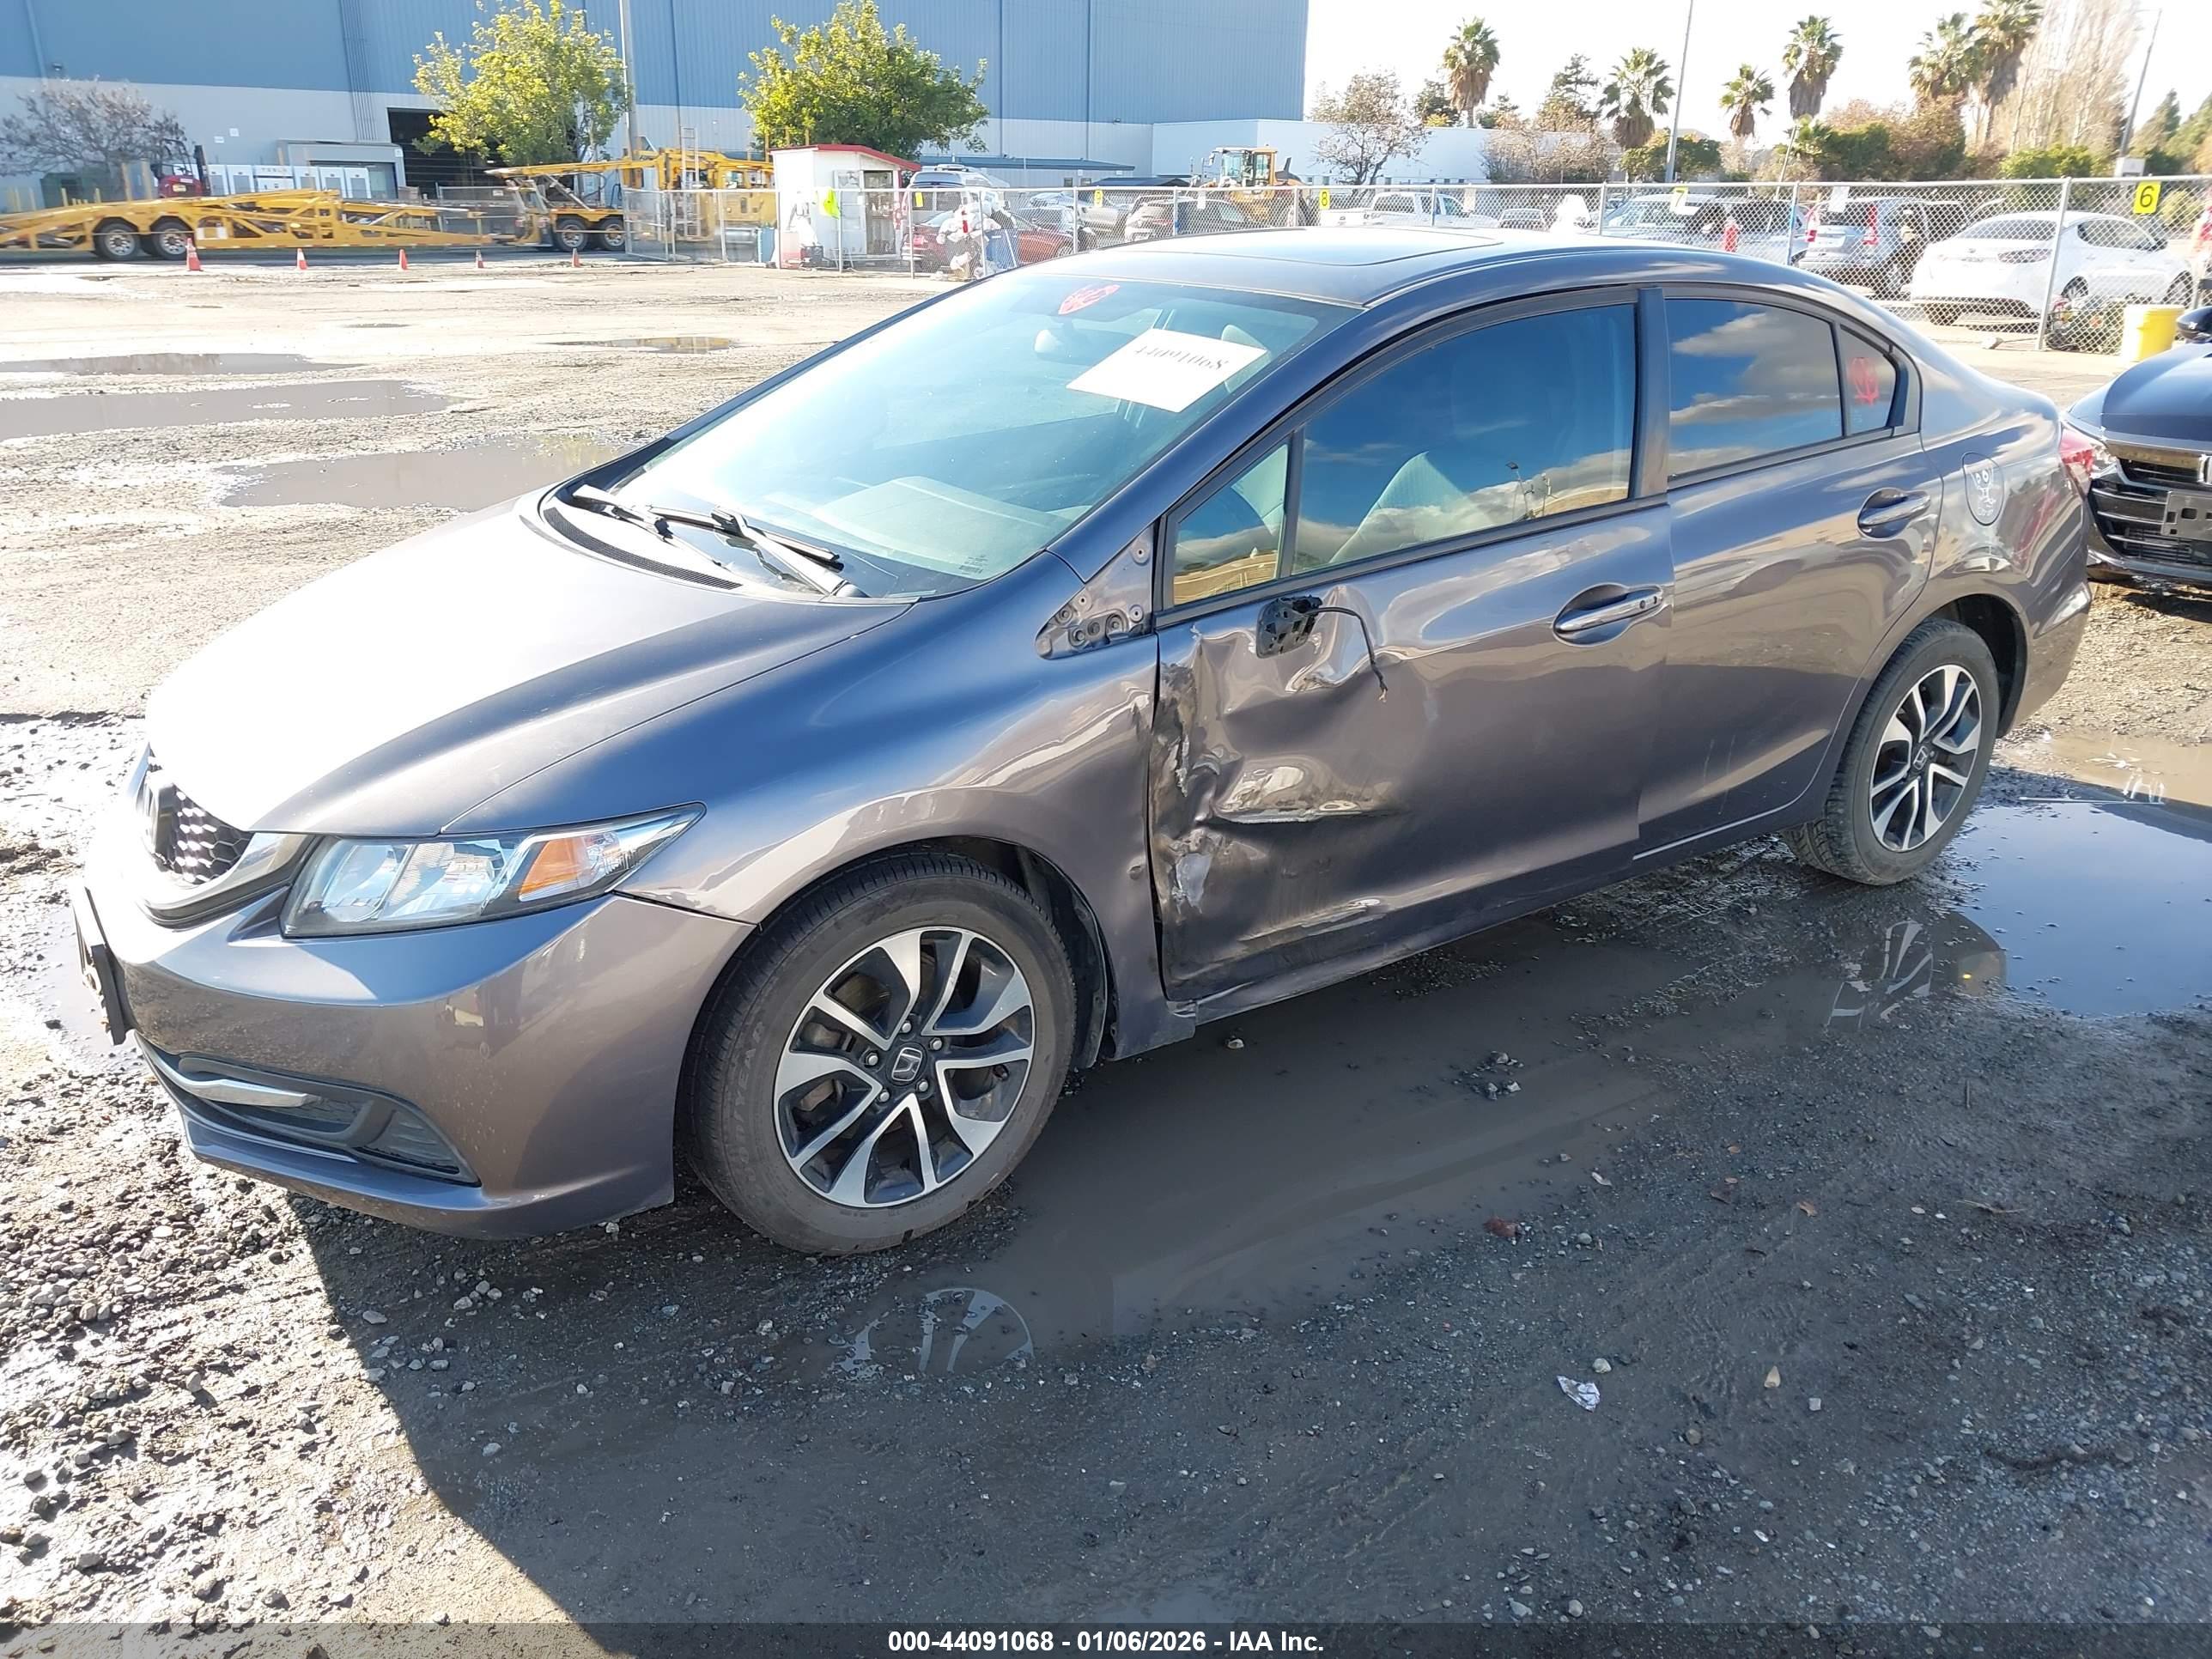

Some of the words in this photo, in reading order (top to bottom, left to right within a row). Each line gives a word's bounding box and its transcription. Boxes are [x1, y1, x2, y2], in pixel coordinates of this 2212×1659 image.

[1322, 191, 1328, 206] 8
[1675, 190, 1685, 207] 7
[2140, 185, 2154, 208] 6
